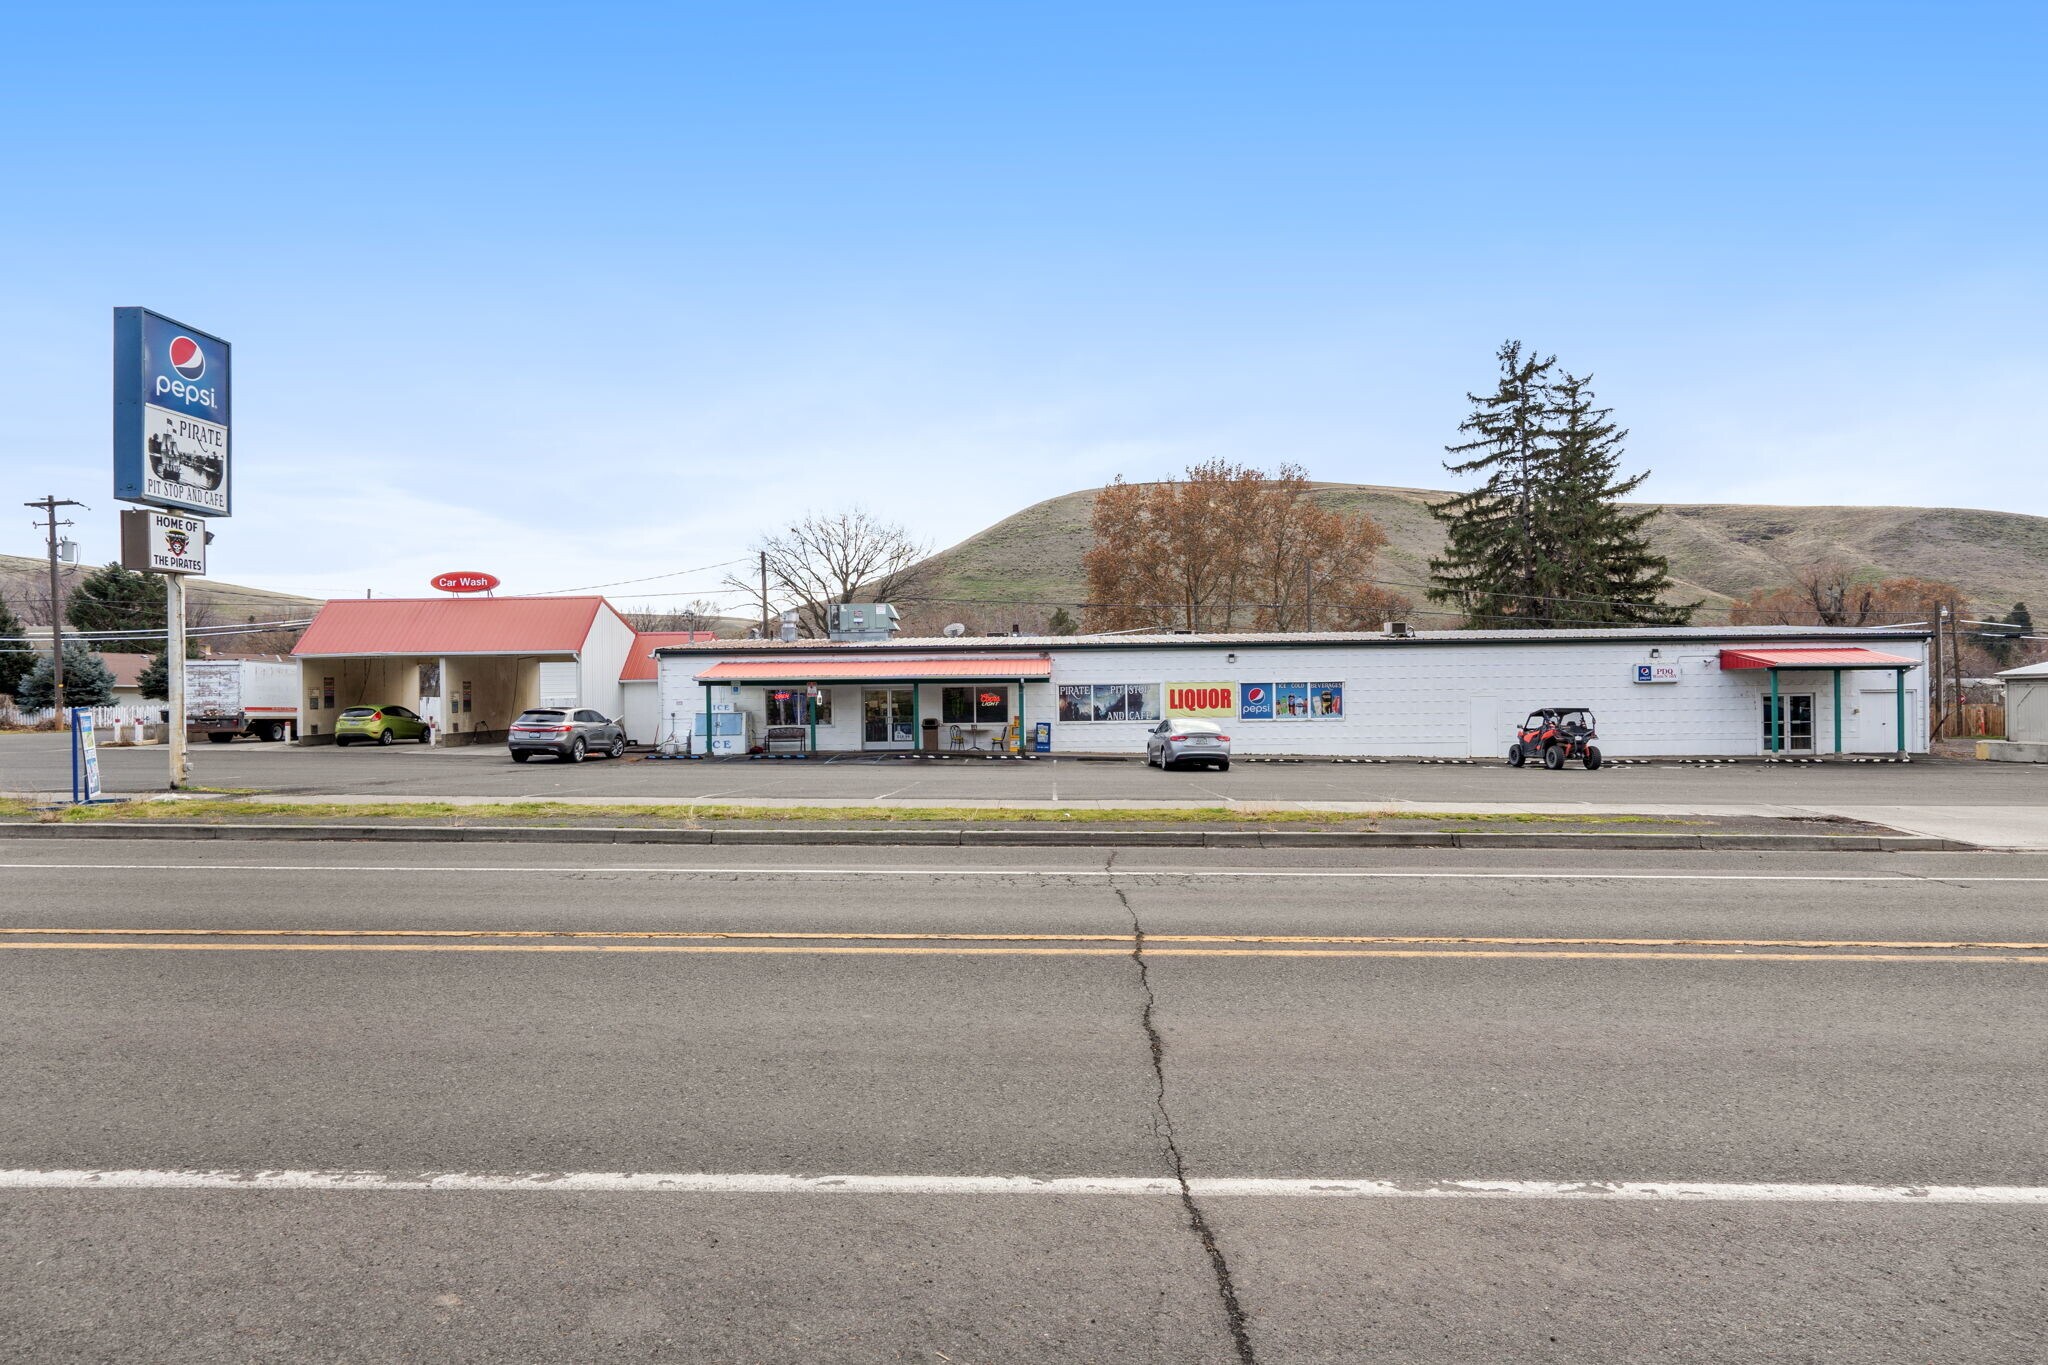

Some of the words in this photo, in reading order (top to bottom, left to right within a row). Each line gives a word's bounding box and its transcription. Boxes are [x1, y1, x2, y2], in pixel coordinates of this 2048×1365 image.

[156, 375, 216, 408] pepsi
[179, 420, 223, 452] PIRATE
[147, 479, 162, 495] PIT
[163, 482, 184, 500] STOP
[187, 487, 203, 503] AND
[205, 490, 224, 507] CAFE
[156, 515, 183, 530] HOME
[185, 521, 198, 532] OF
[153, 554, 169, 566] THE
[171, 556, 202, 571] PIRATES
[439, 578, 457, 587] Car
[460, 577, 488, 586] Wash
[1059, 686, 1091, 700] PIRATE
[1110, 685, 1124, 694] PIT
[1169, 688, 1232, 711] LIQUOR
[1106, 711, 1125, 720] AND
[1129, 711, 1153, 720] CAFE
[1242, 704, 1270, 714] pepsi
[709, 740, 732, 749] CE
